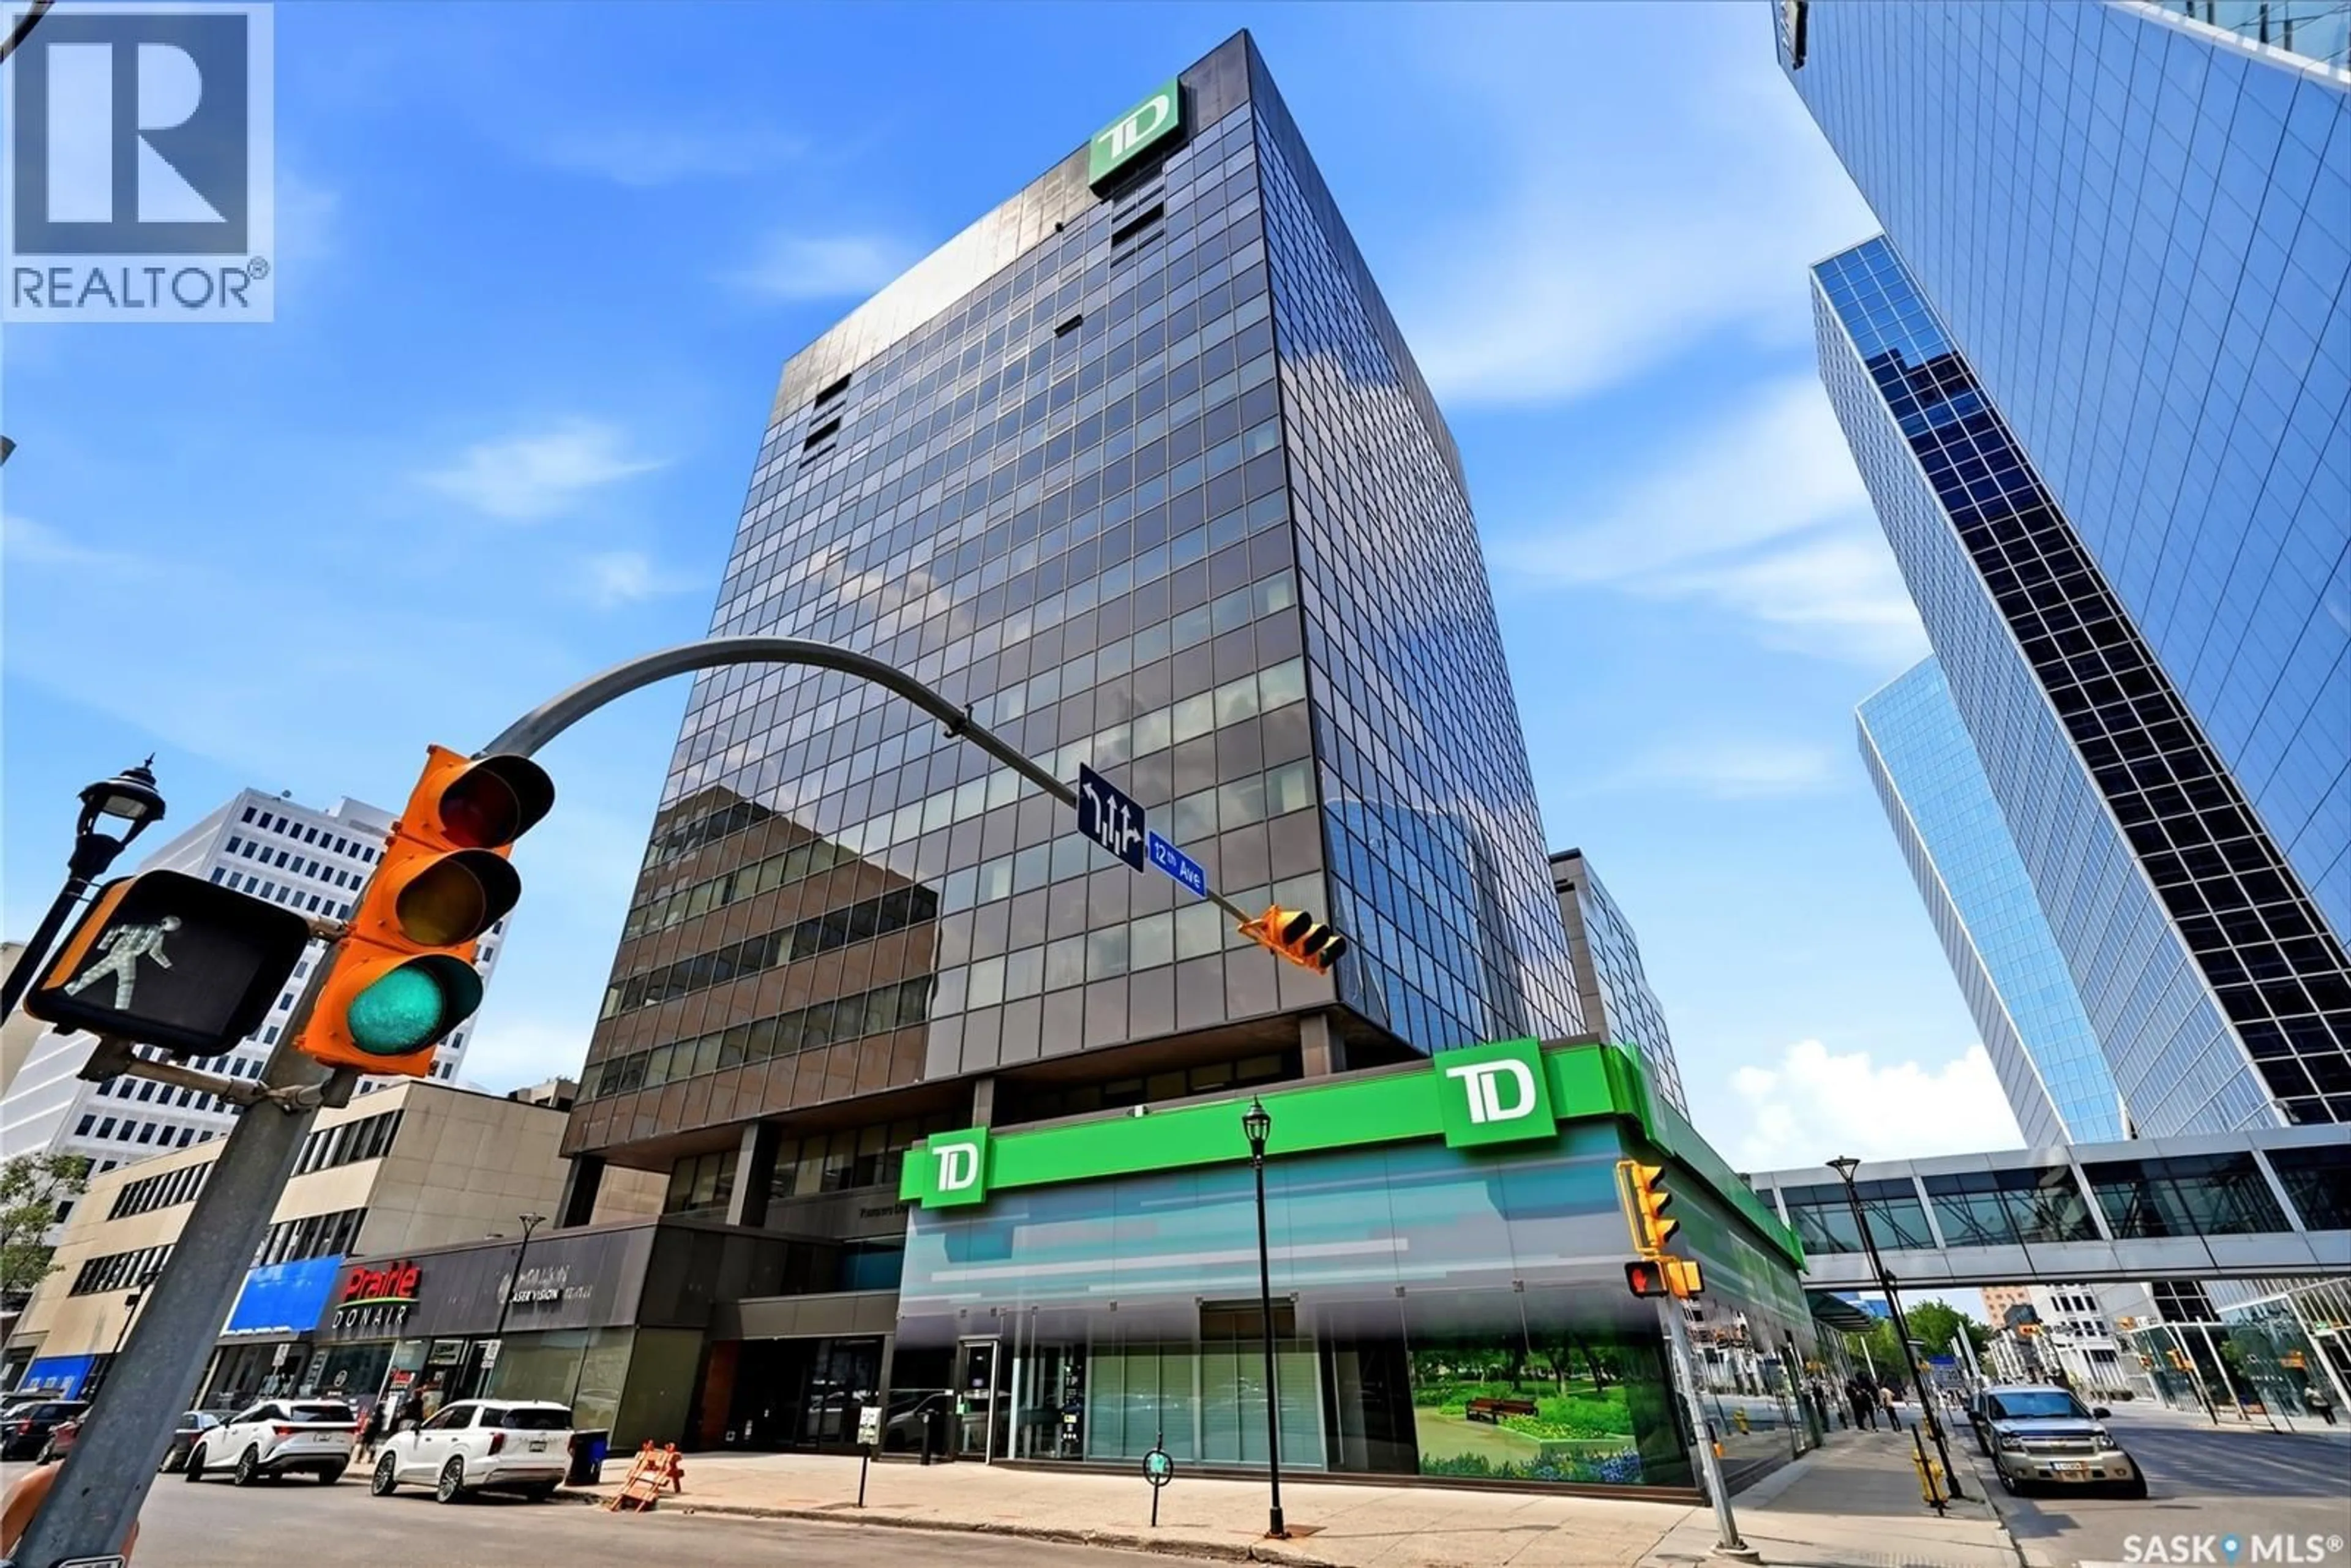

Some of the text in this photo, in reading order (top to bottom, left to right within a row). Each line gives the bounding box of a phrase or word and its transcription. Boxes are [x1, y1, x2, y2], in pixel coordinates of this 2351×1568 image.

[1097, 94, 1169, 159] TD
[1155, 842, 1201, 888] 12th Ave
[1445, 1059, 1537, 1123] TD
[932, 1142, 979, 1192] TD
[340, 1262, 420, 1303] Prairie
[332, 1305, 407, 1329] DONAIR
